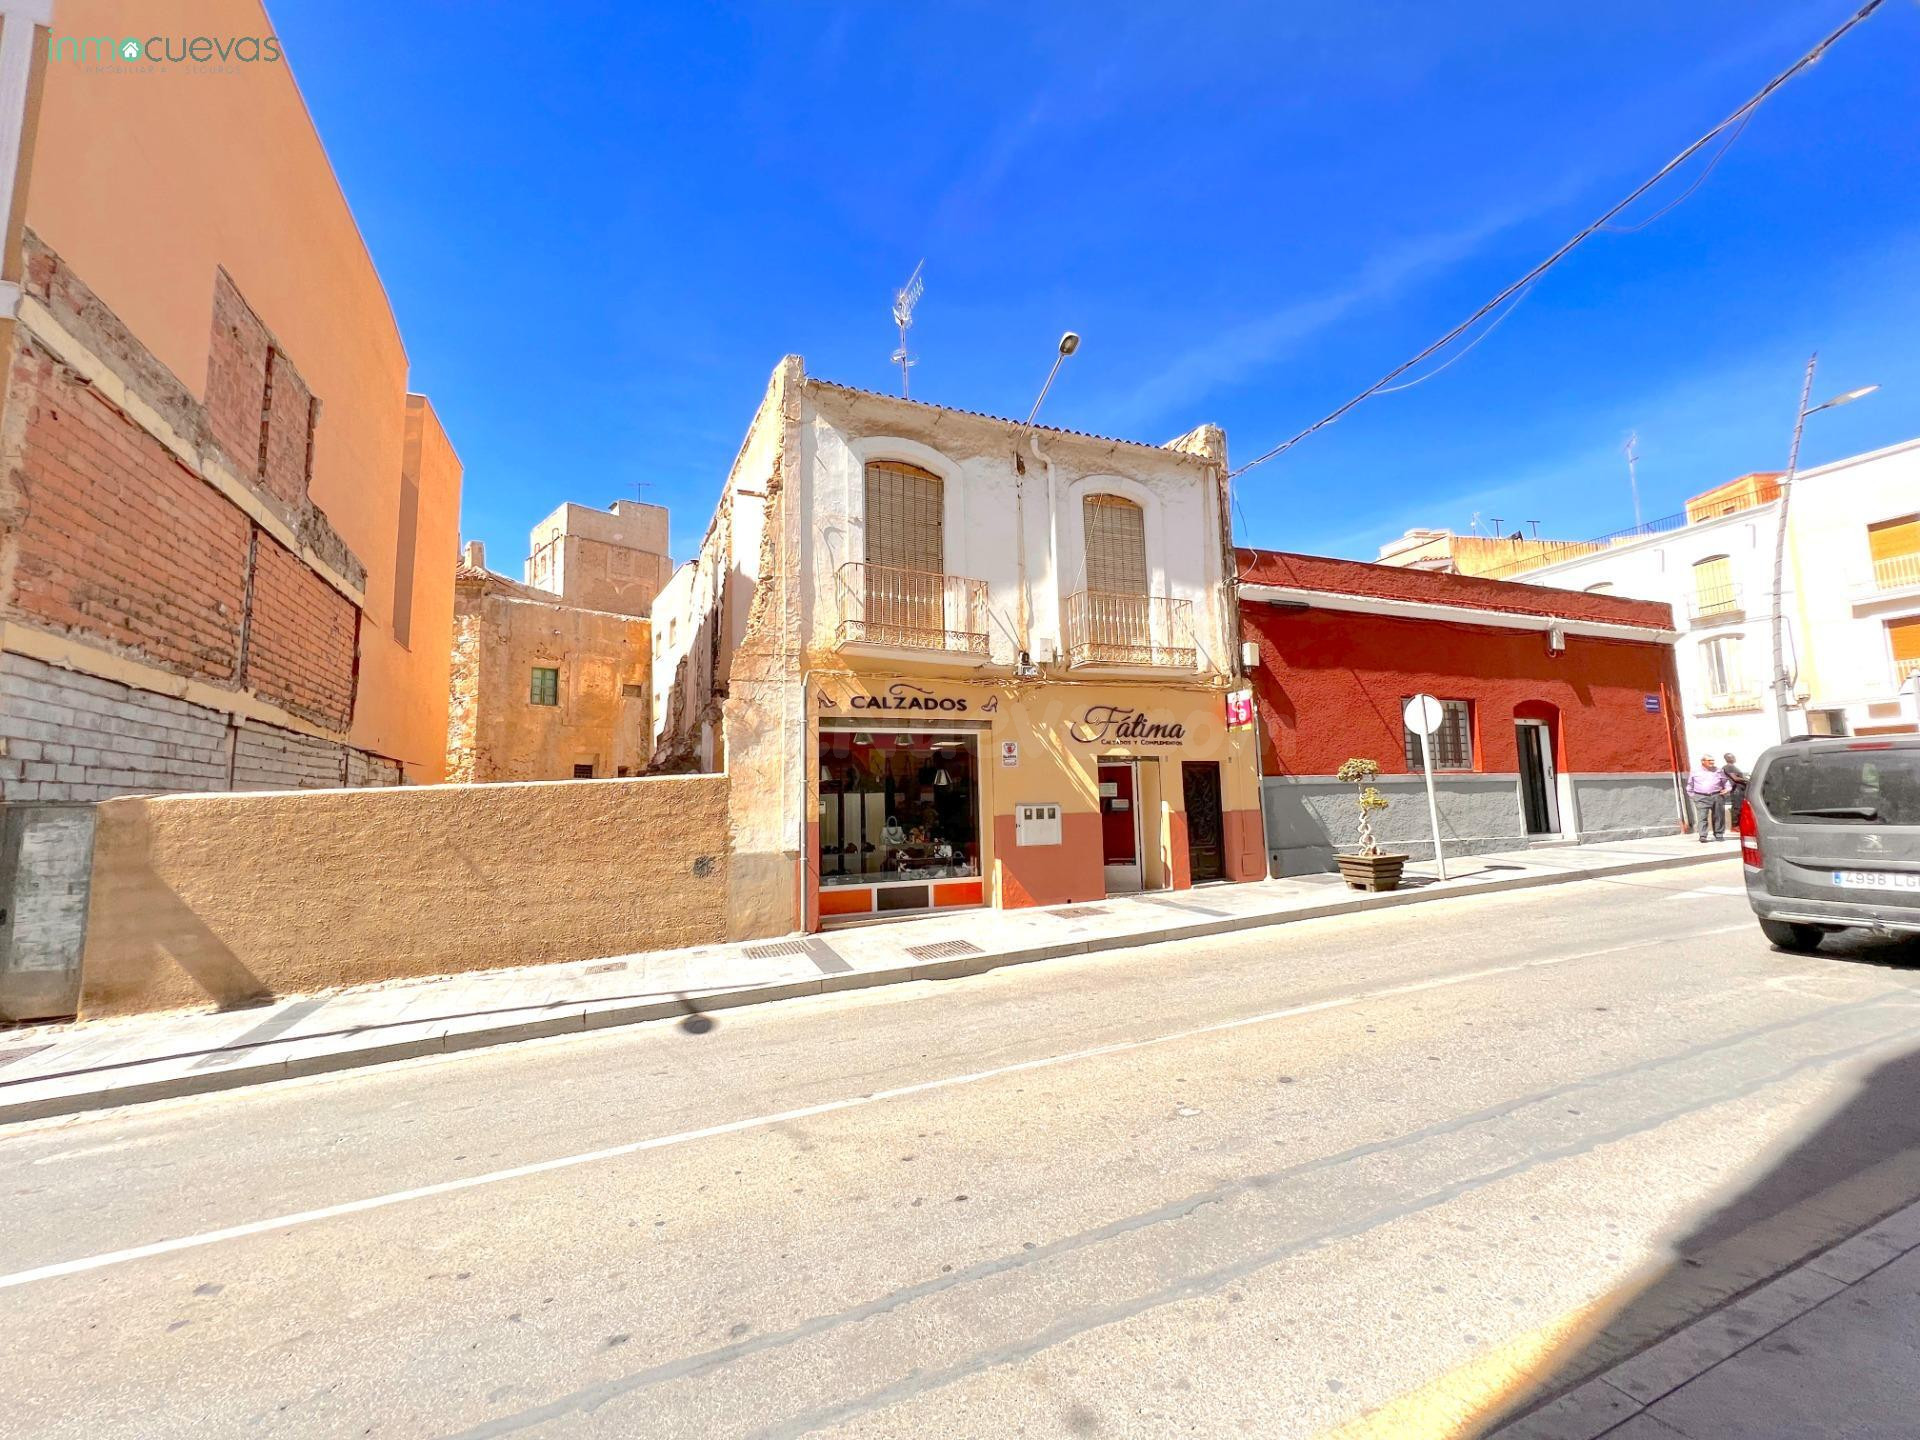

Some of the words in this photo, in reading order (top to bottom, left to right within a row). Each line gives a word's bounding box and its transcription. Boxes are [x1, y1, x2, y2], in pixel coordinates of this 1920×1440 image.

[850, 695, 968, 712] CALZADOS
[1070, 705, 1186, 744] Fátima
[1894, 873, 1920, 888] LG
